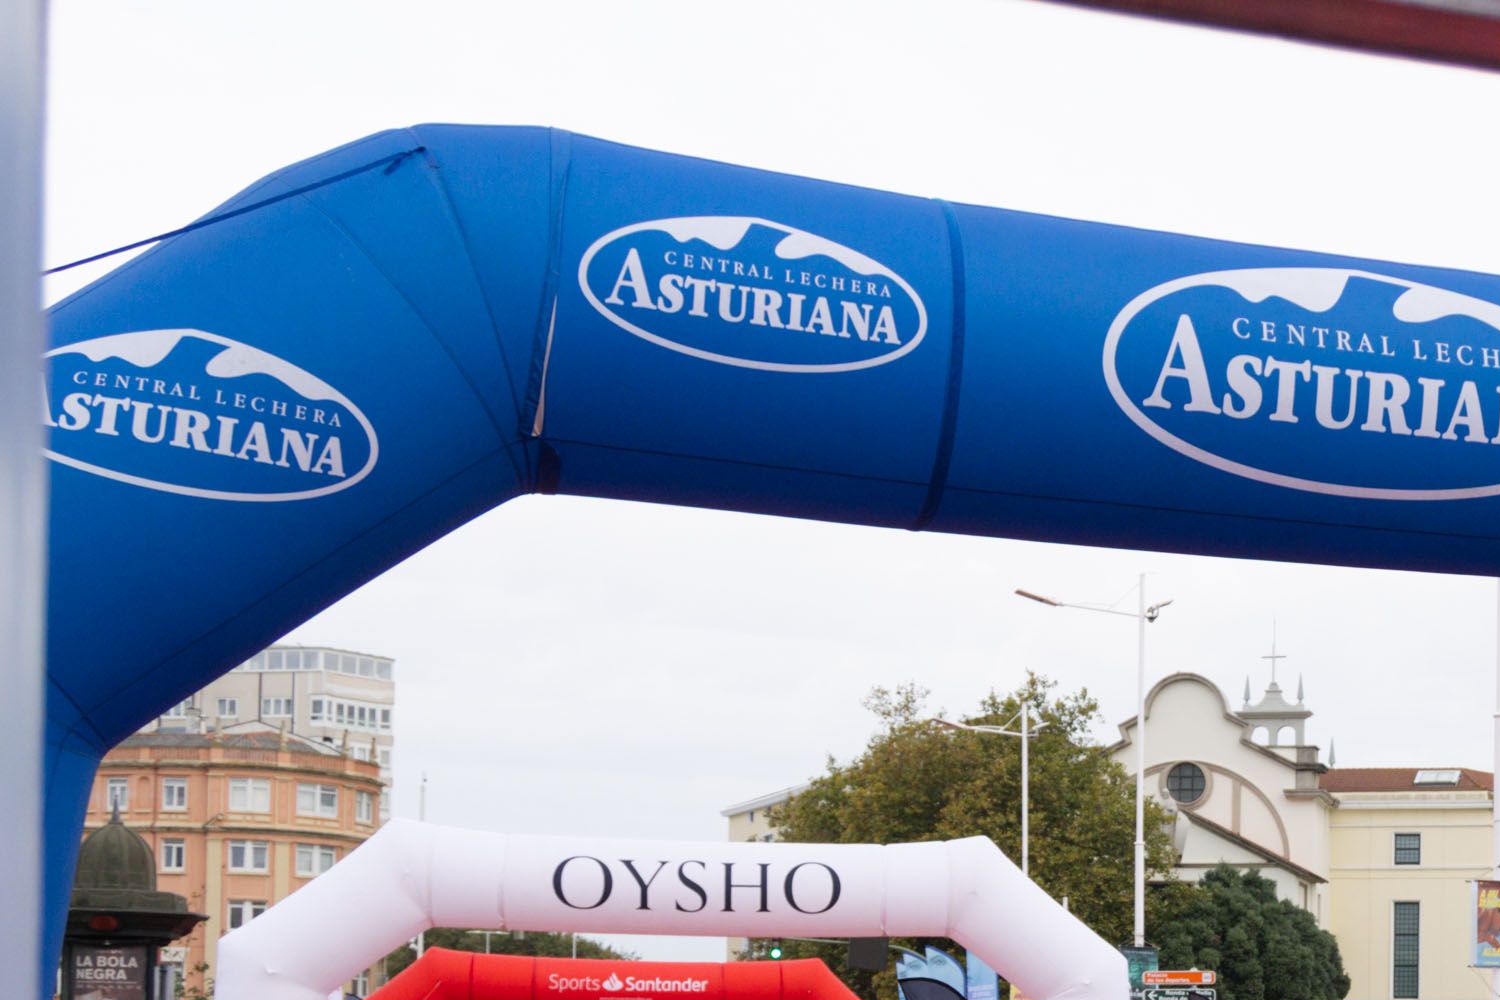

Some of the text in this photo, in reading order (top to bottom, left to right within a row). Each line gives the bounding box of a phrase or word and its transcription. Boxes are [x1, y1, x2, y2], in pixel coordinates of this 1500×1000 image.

[664, 249, 892, 297] CENTRAL LECHERA
[605, 248, 902, 347] ASTURIANA
[1232, 316, 1396, 357] CENTRAL
[73, 370, 342, 428] CENTRAL LECHERA
[553, 855, 841, 914] OYSHO
[76, 956, 138, 968] LA BOLA
[76, 968, 127, 980] NEGRA
[548, 973, 709, 992] Sports Santander
